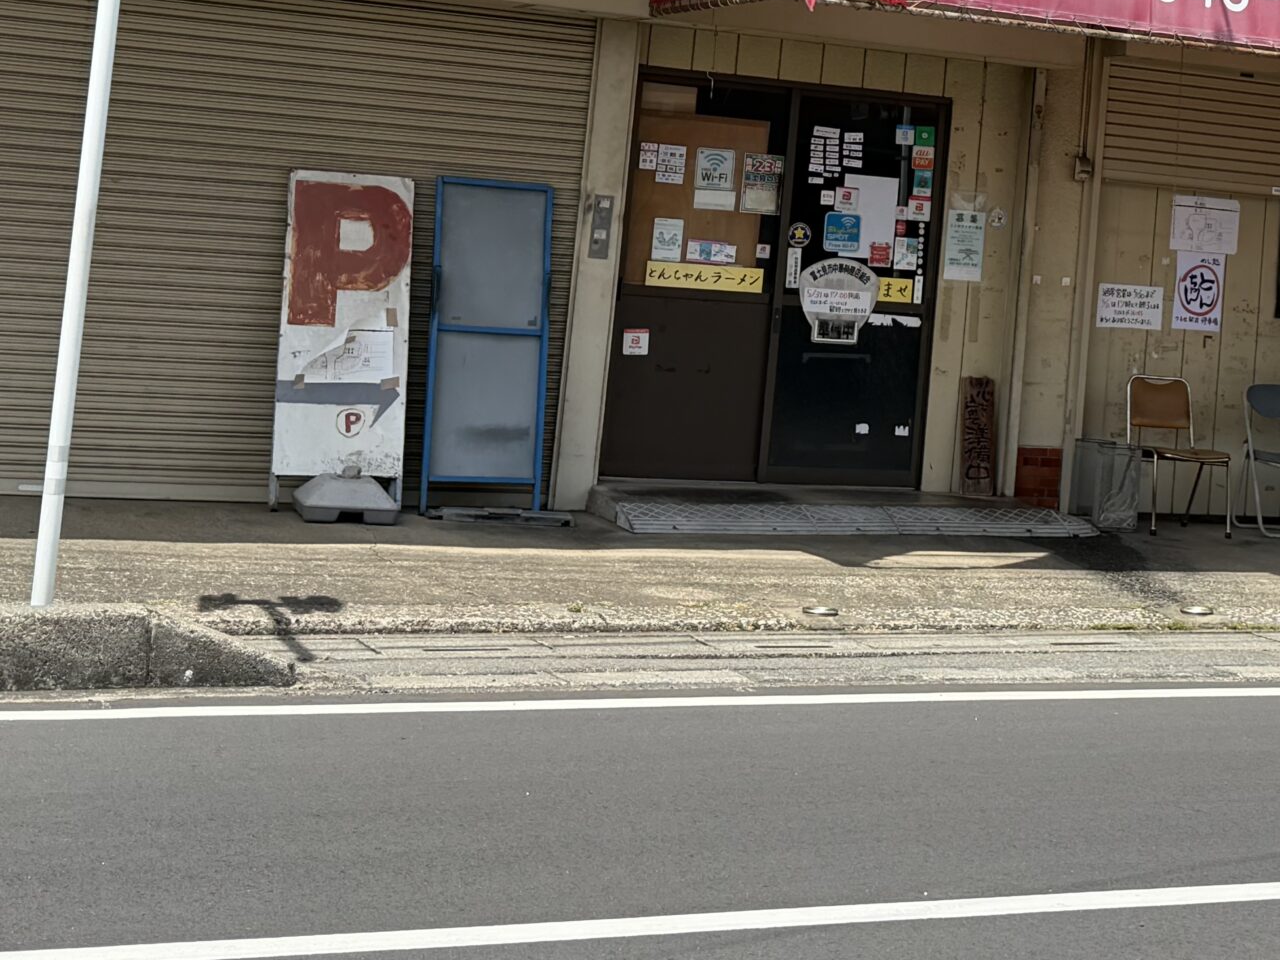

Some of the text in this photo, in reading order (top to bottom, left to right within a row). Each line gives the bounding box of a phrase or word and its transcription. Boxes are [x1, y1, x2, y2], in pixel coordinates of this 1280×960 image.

[701, 171, 728, 183] Wi-Fi
[287, 180, 413, 327] P
[648, 268, 761, 286] とんちゃんラーメン
[878, 281, 908, 298] ませ
